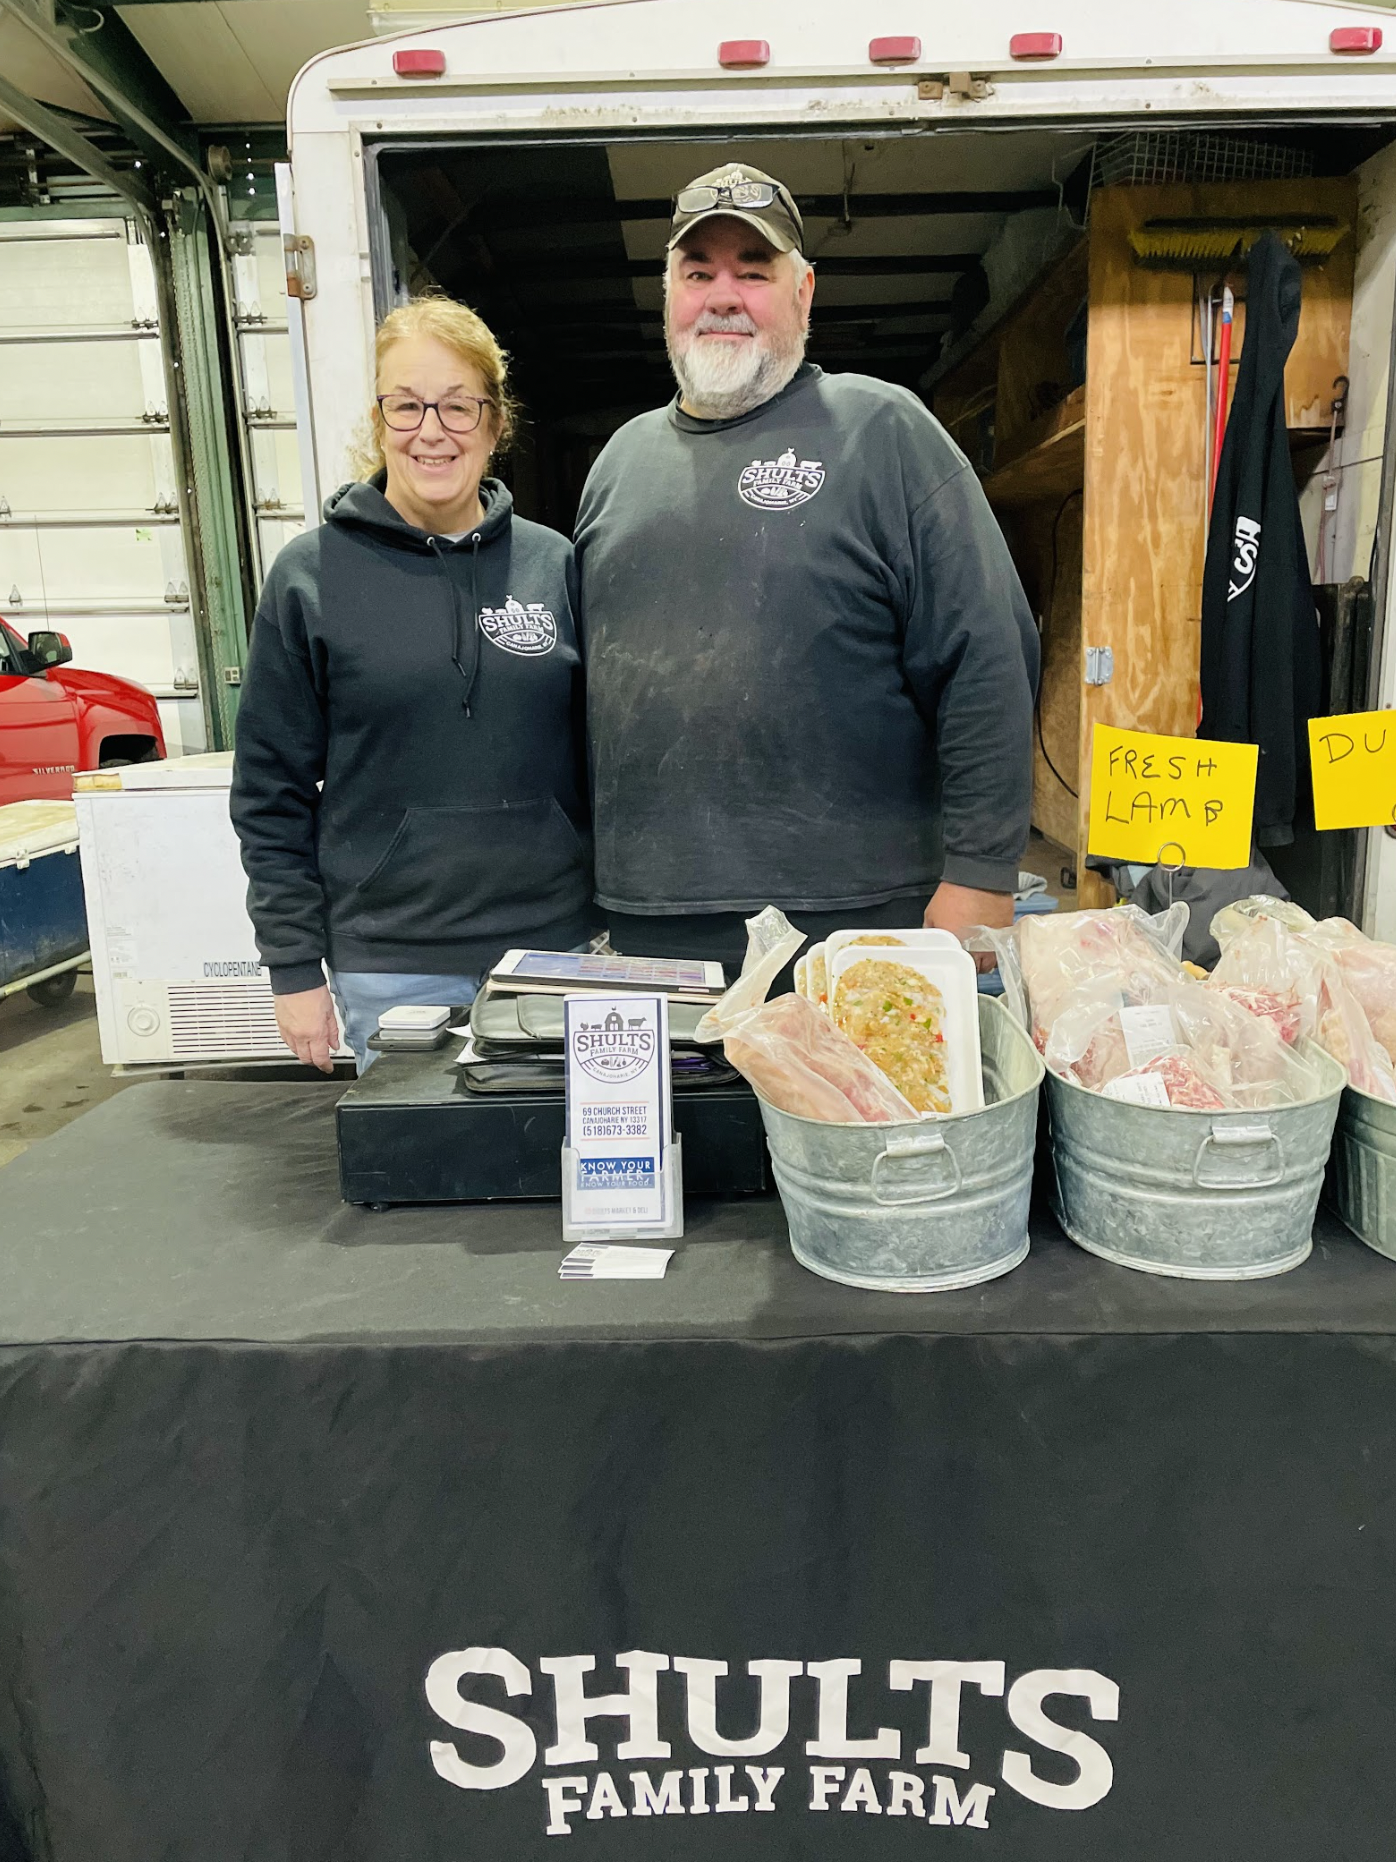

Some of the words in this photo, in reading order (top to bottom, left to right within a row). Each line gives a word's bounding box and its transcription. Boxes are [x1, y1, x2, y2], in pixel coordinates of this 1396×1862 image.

[742, 468, 820, 487] SHULTS
[753, 478, 782, 487] FAMILY
[782, 479, 803, 490] FARM
[483, 614, 553, 632] SHULTS
[500, 624, 524, 634] FAMILY
[525, 623, 544, 632] FARM
[1109, 746, 1217, 780] FRESH
[32, 765, 75, 775] SILVERADO
[203, 961, 262, 977] CYCLOPENTANE
[577, 1033, 651, 1052] SHULTS
[590, 1047, 616, 1057] FAMILY
[618, 1047, 639, 1056] FARM
[582, 1107, 592, 1116] 69
[593, 1106, 621, 1116] CHURCH
[622, 1106, 647, 1115] STREET
[582, 1116, 619, 1124] CANAJOHARIE
[583, 1124, 647, 1136] (518)673-3382
[580, 1162, 616, 1171] KNOW
[620, 1161, 651, 1169] YOUR
[581, 1169, 649, 1183] FARMER,
[424, 1646, 1120, 1811] SHULTS
[542, 1764, 785, 1836] FAMILY
[808, 1765, 997, 1830] FARM
